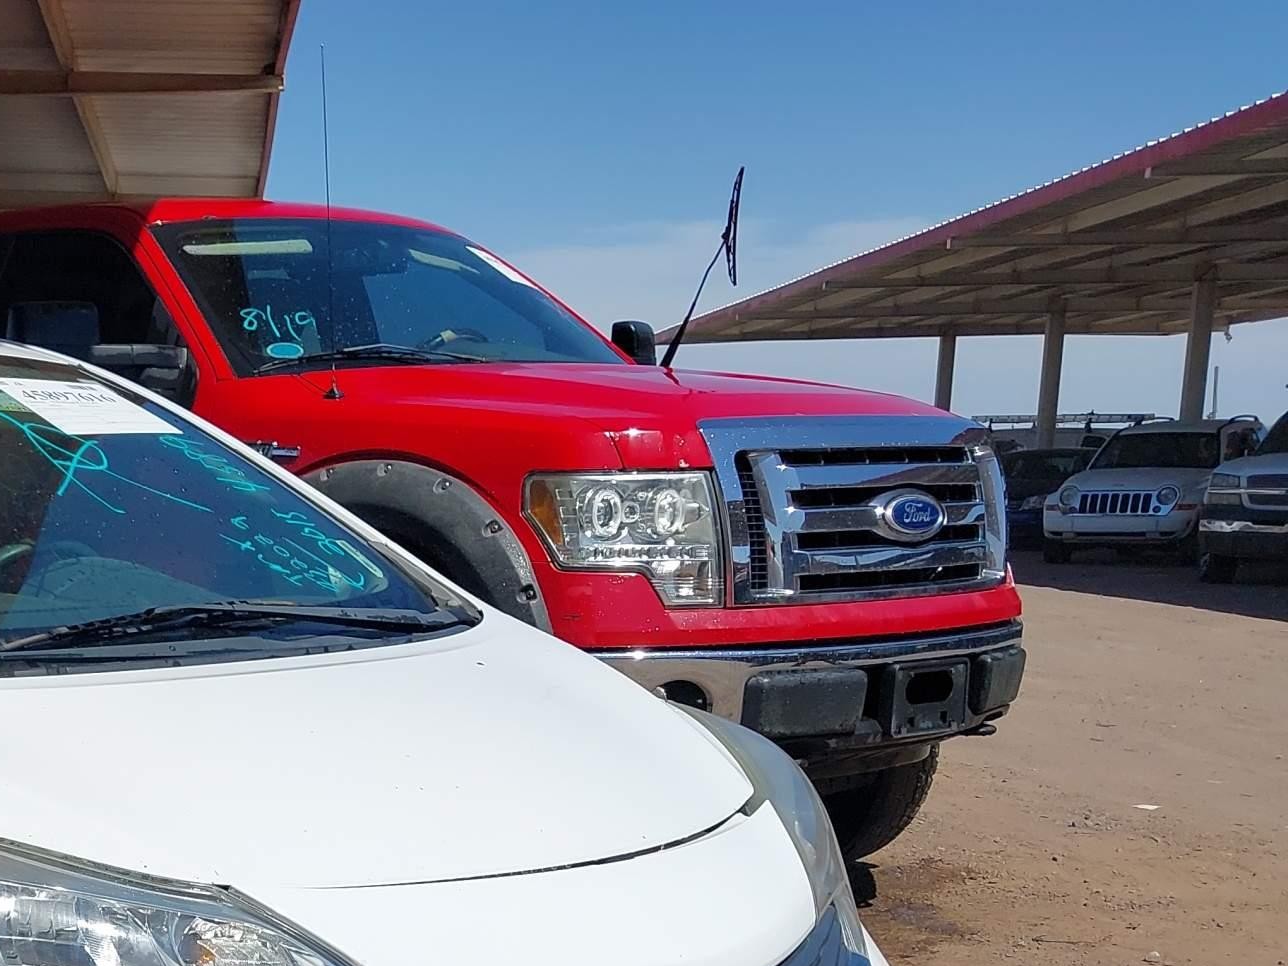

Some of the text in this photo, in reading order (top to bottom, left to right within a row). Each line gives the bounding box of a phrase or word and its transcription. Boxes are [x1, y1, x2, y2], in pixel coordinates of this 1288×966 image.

[239, 304, 320, 341] 8/19
[22, 389, 117, 404] 45897616
[903, 502, 933, 523] Ford
